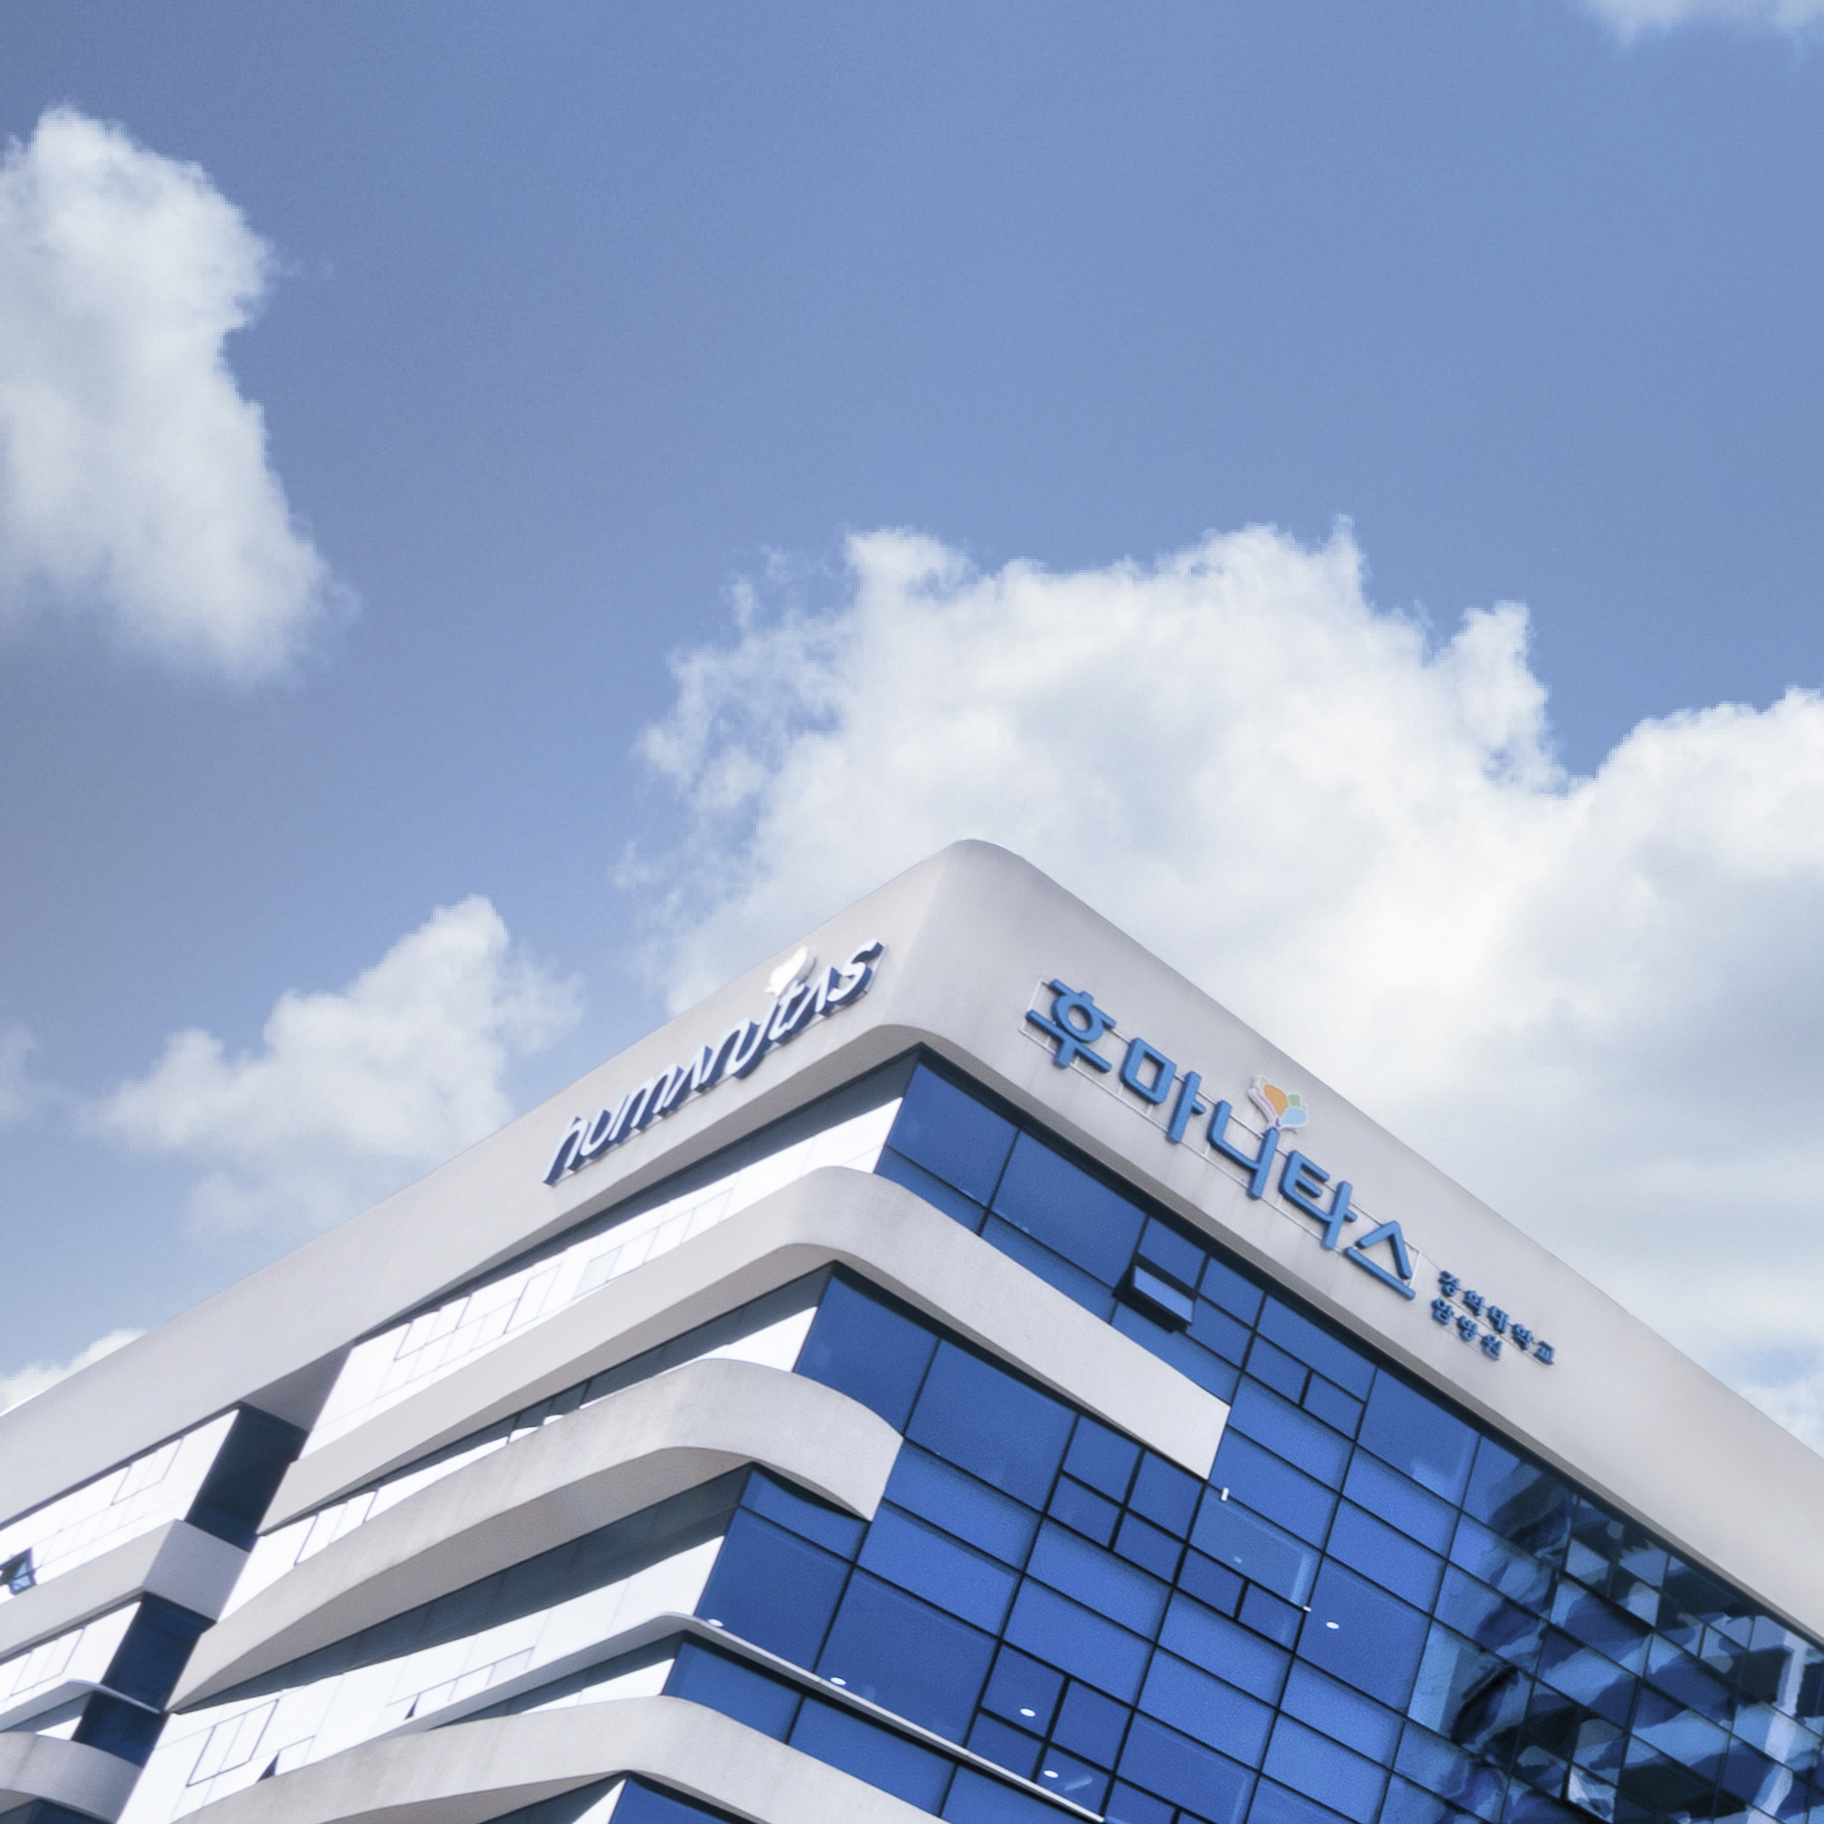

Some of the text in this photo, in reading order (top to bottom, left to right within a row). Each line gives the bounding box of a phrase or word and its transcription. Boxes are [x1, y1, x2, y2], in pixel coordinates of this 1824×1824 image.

[1025, 978, 1416, 1300] 후마니타스
[1431, 1298, 1502, 1361] 암병원
[1437, 1270, 1555, 1365] 경희대학교
